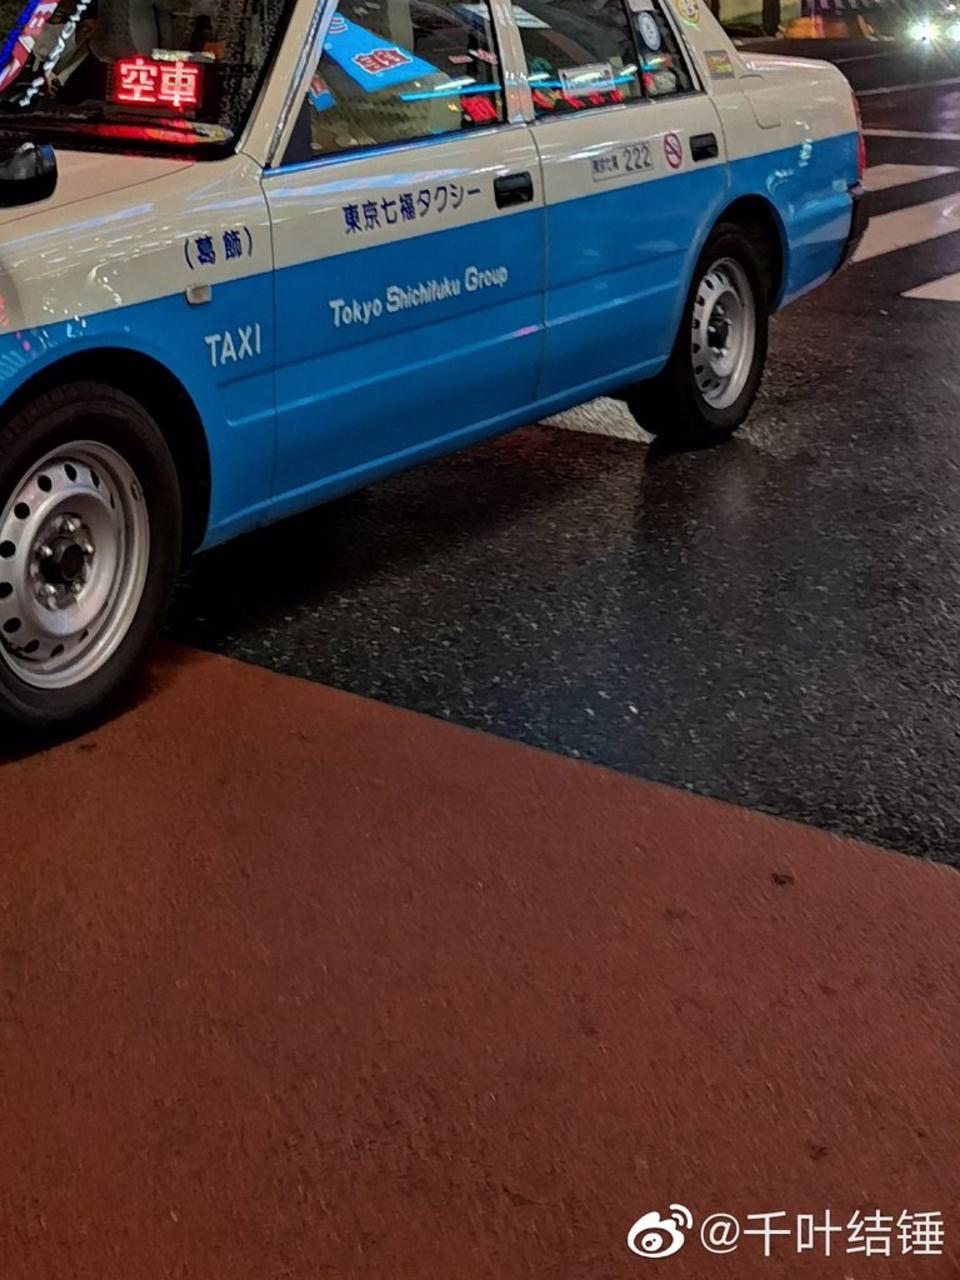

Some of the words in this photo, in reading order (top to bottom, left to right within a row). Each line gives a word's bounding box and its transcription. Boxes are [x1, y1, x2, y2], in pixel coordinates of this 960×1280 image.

[118, 58, 199, 107] 空車
[624, 143, 652, 172] 222
[342, 184, 482, 235] 東京七福タクシー
[328, 298, 382, 328] Tokyo
[386, 276, 461, 313] Shichifuku
[465, 265, 509, 292] Group
[204, 322, 262, 368] TAXI
